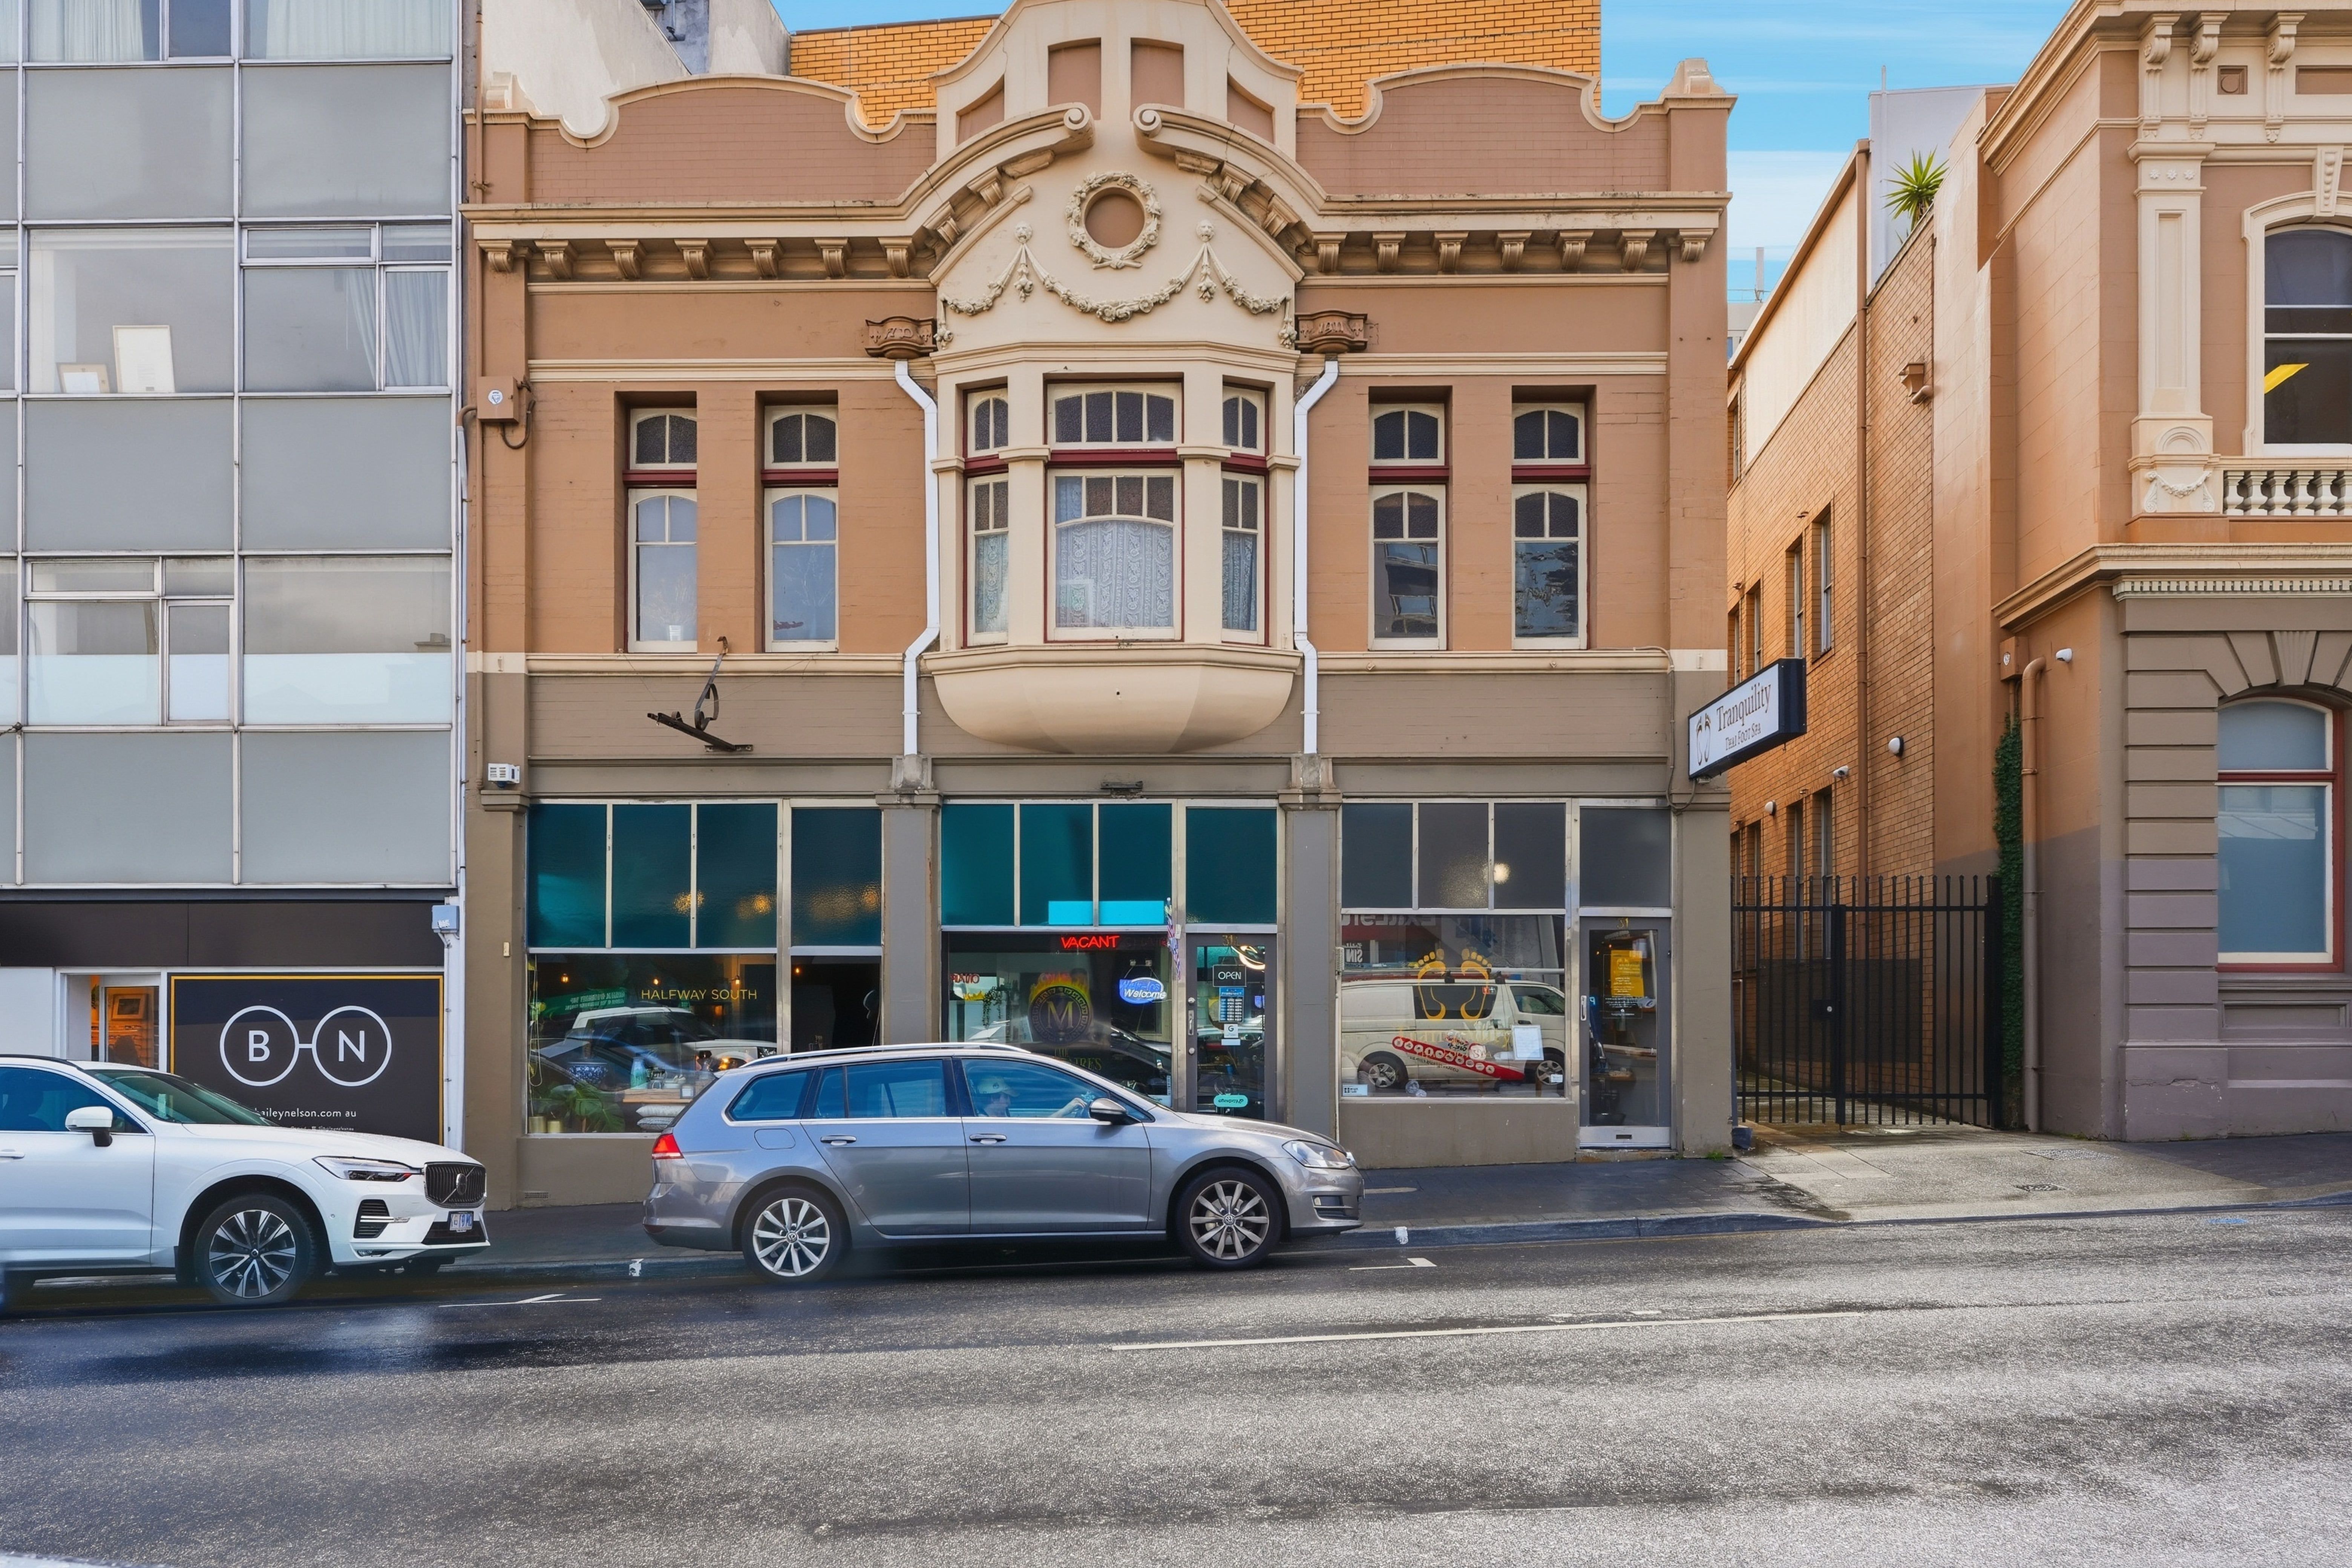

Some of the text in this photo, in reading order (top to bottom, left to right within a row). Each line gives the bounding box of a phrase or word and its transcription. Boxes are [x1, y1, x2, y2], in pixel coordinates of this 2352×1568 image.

[1716, 683, 1771, 732] Tranquility
[1751, 722, 1762, 738] SPA
[1061, 935, 1120, 949] VACANT
[1218, 971, 1242, 980] OPEN
[641, 989, 757, 1000] HALFWAY SOUTH
[1124, 988, 1168, 999] Welcome
[1047, 1001, 1074, 1029] M
[249, 1030, 365, 1063] B N
